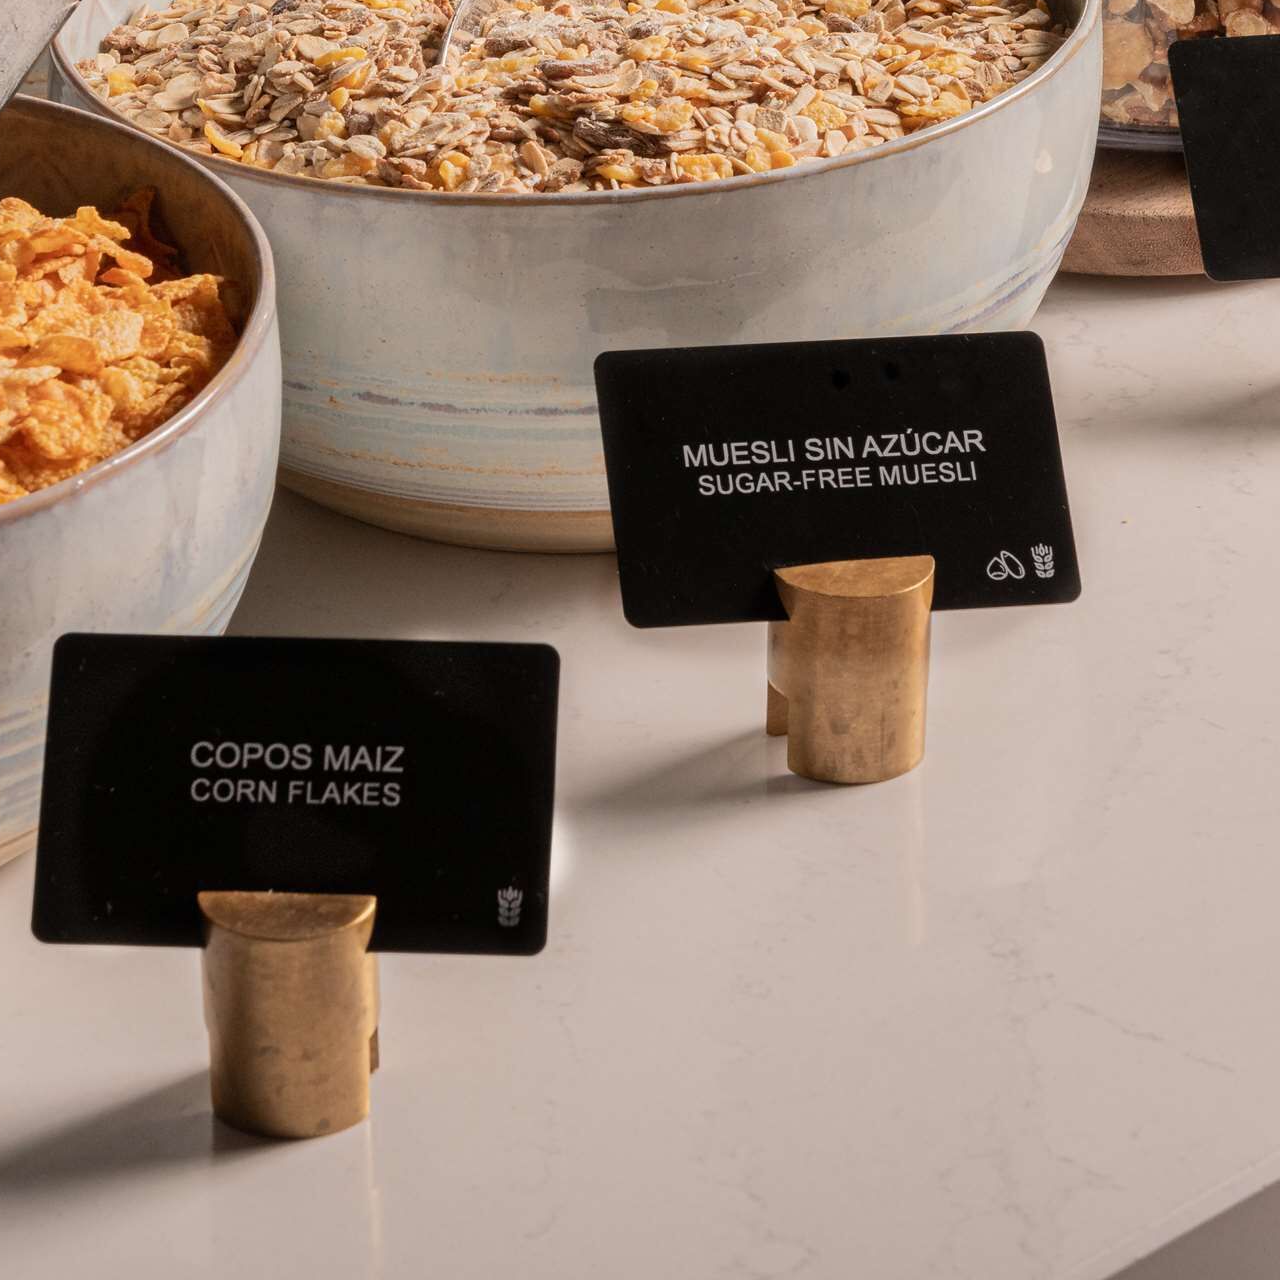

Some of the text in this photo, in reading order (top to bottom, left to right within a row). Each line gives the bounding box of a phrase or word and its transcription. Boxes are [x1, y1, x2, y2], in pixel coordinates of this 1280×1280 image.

[682, 426, 987, 468] MUESLI SIN AZÚCAR
[698, 461, 977, 496] SUGAR-FREE MUESLI
[190, 741, 405, 774] COPOS MAIZ
[190, 778, 402, 807] CORN FLAKES
